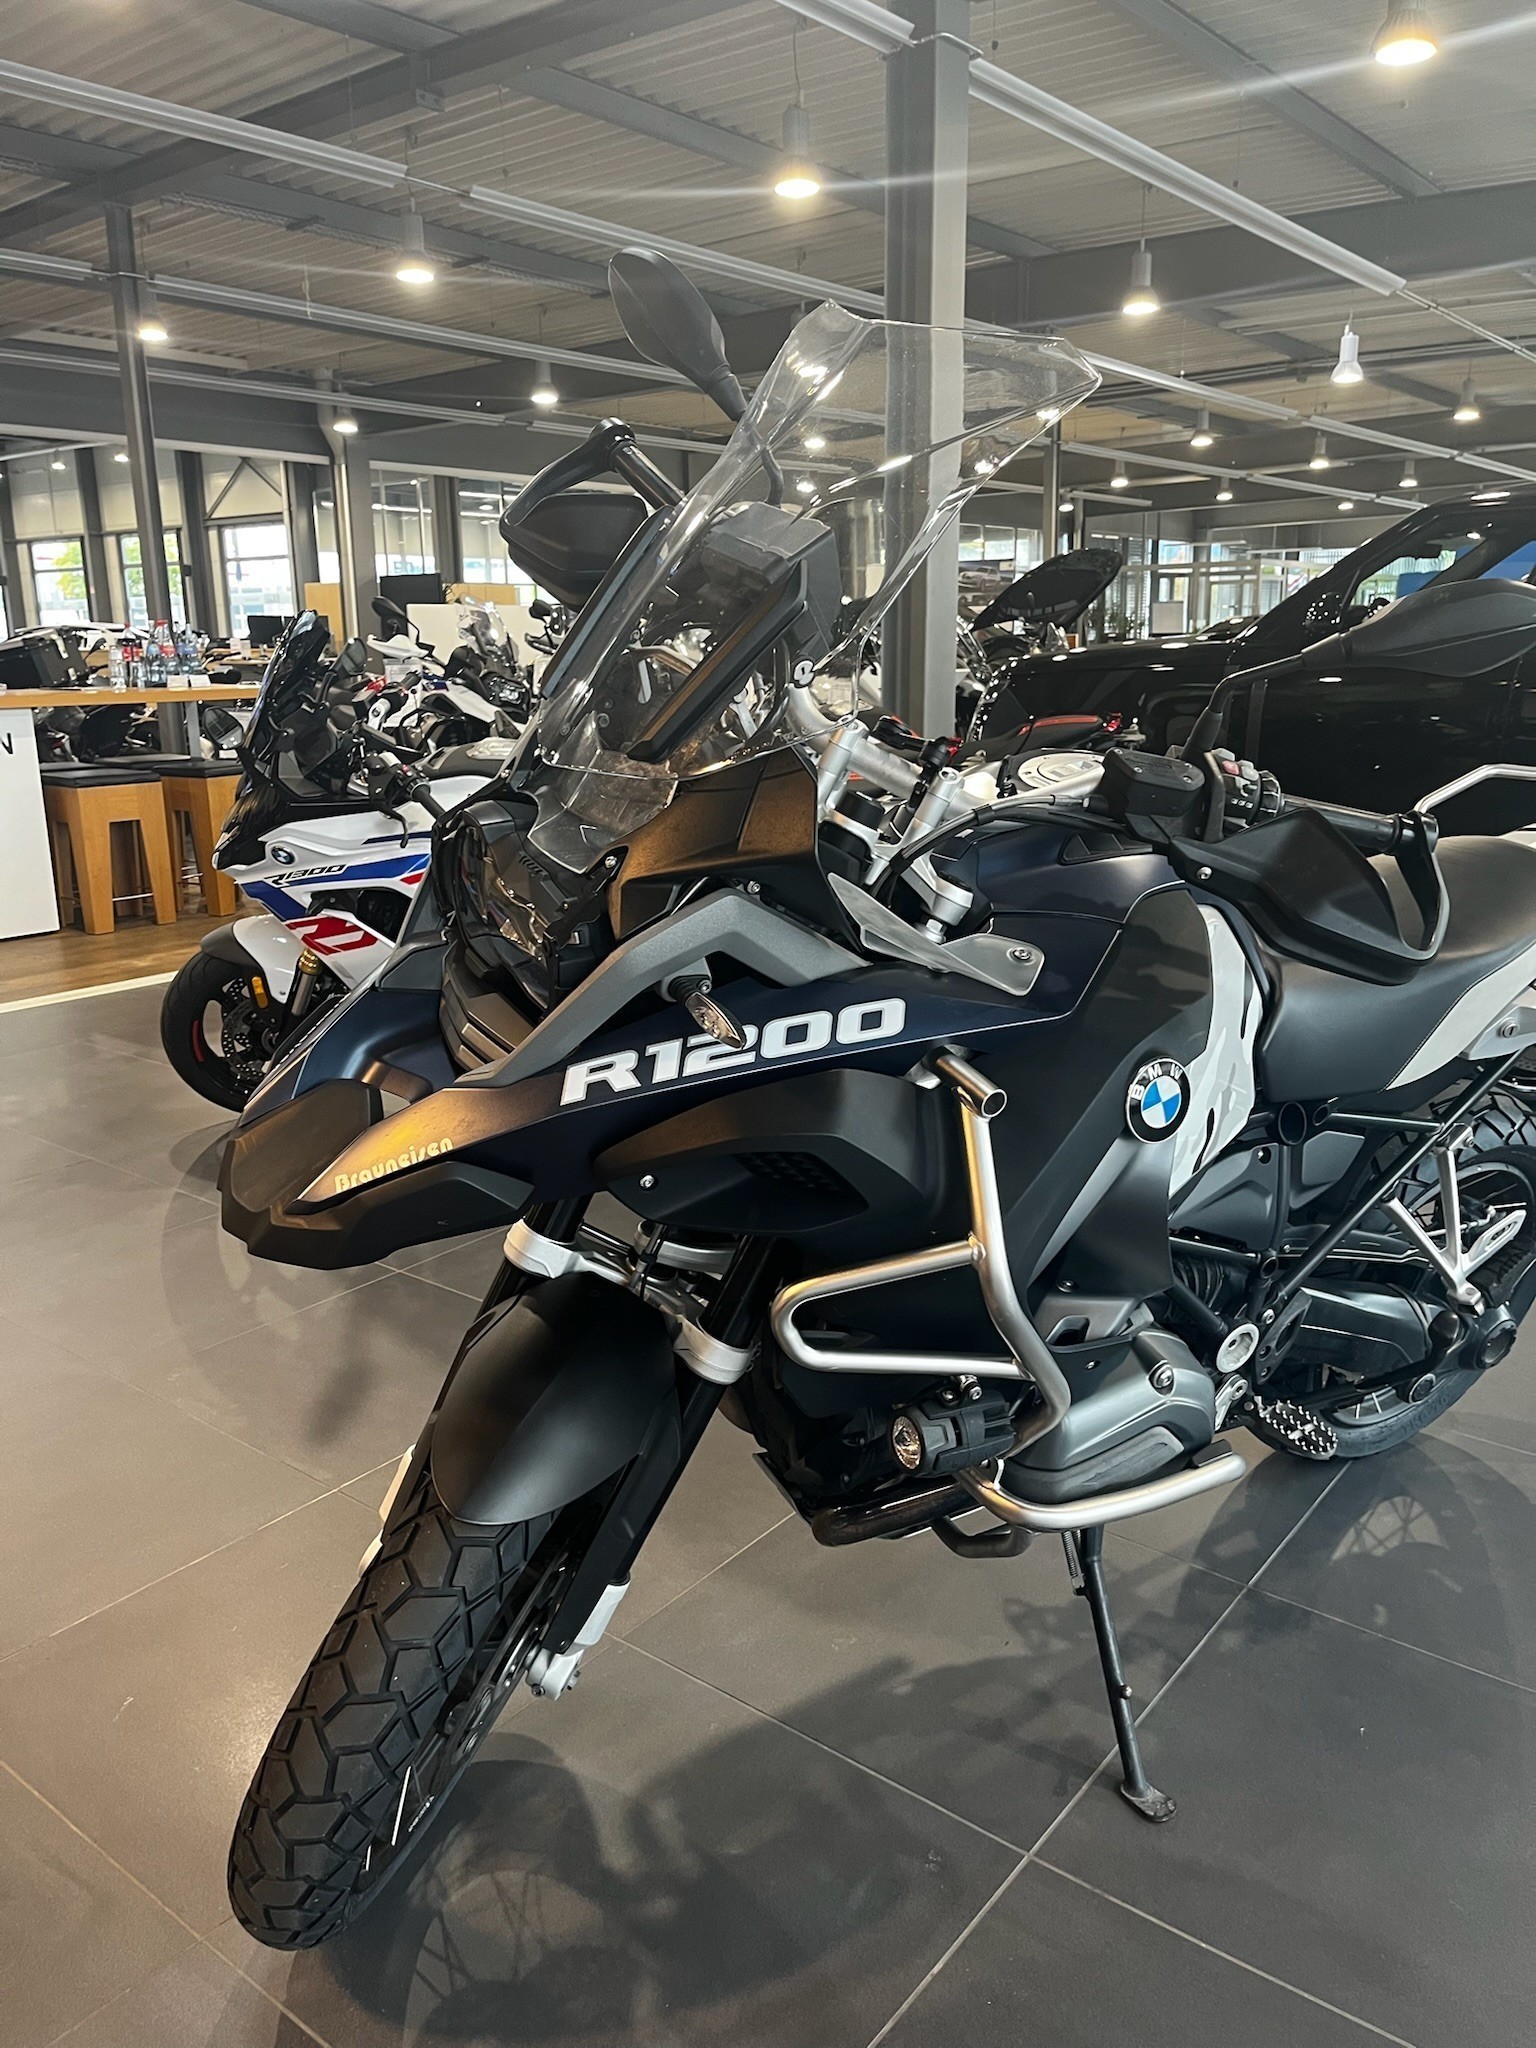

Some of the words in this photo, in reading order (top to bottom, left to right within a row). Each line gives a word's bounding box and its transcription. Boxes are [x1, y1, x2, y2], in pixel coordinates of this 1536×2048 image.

[560, 997, 906, 1107] R1200
[1130, 1062, 1184, 1101] BMW
[334, 1137, 454, 1194] Brauneisen
